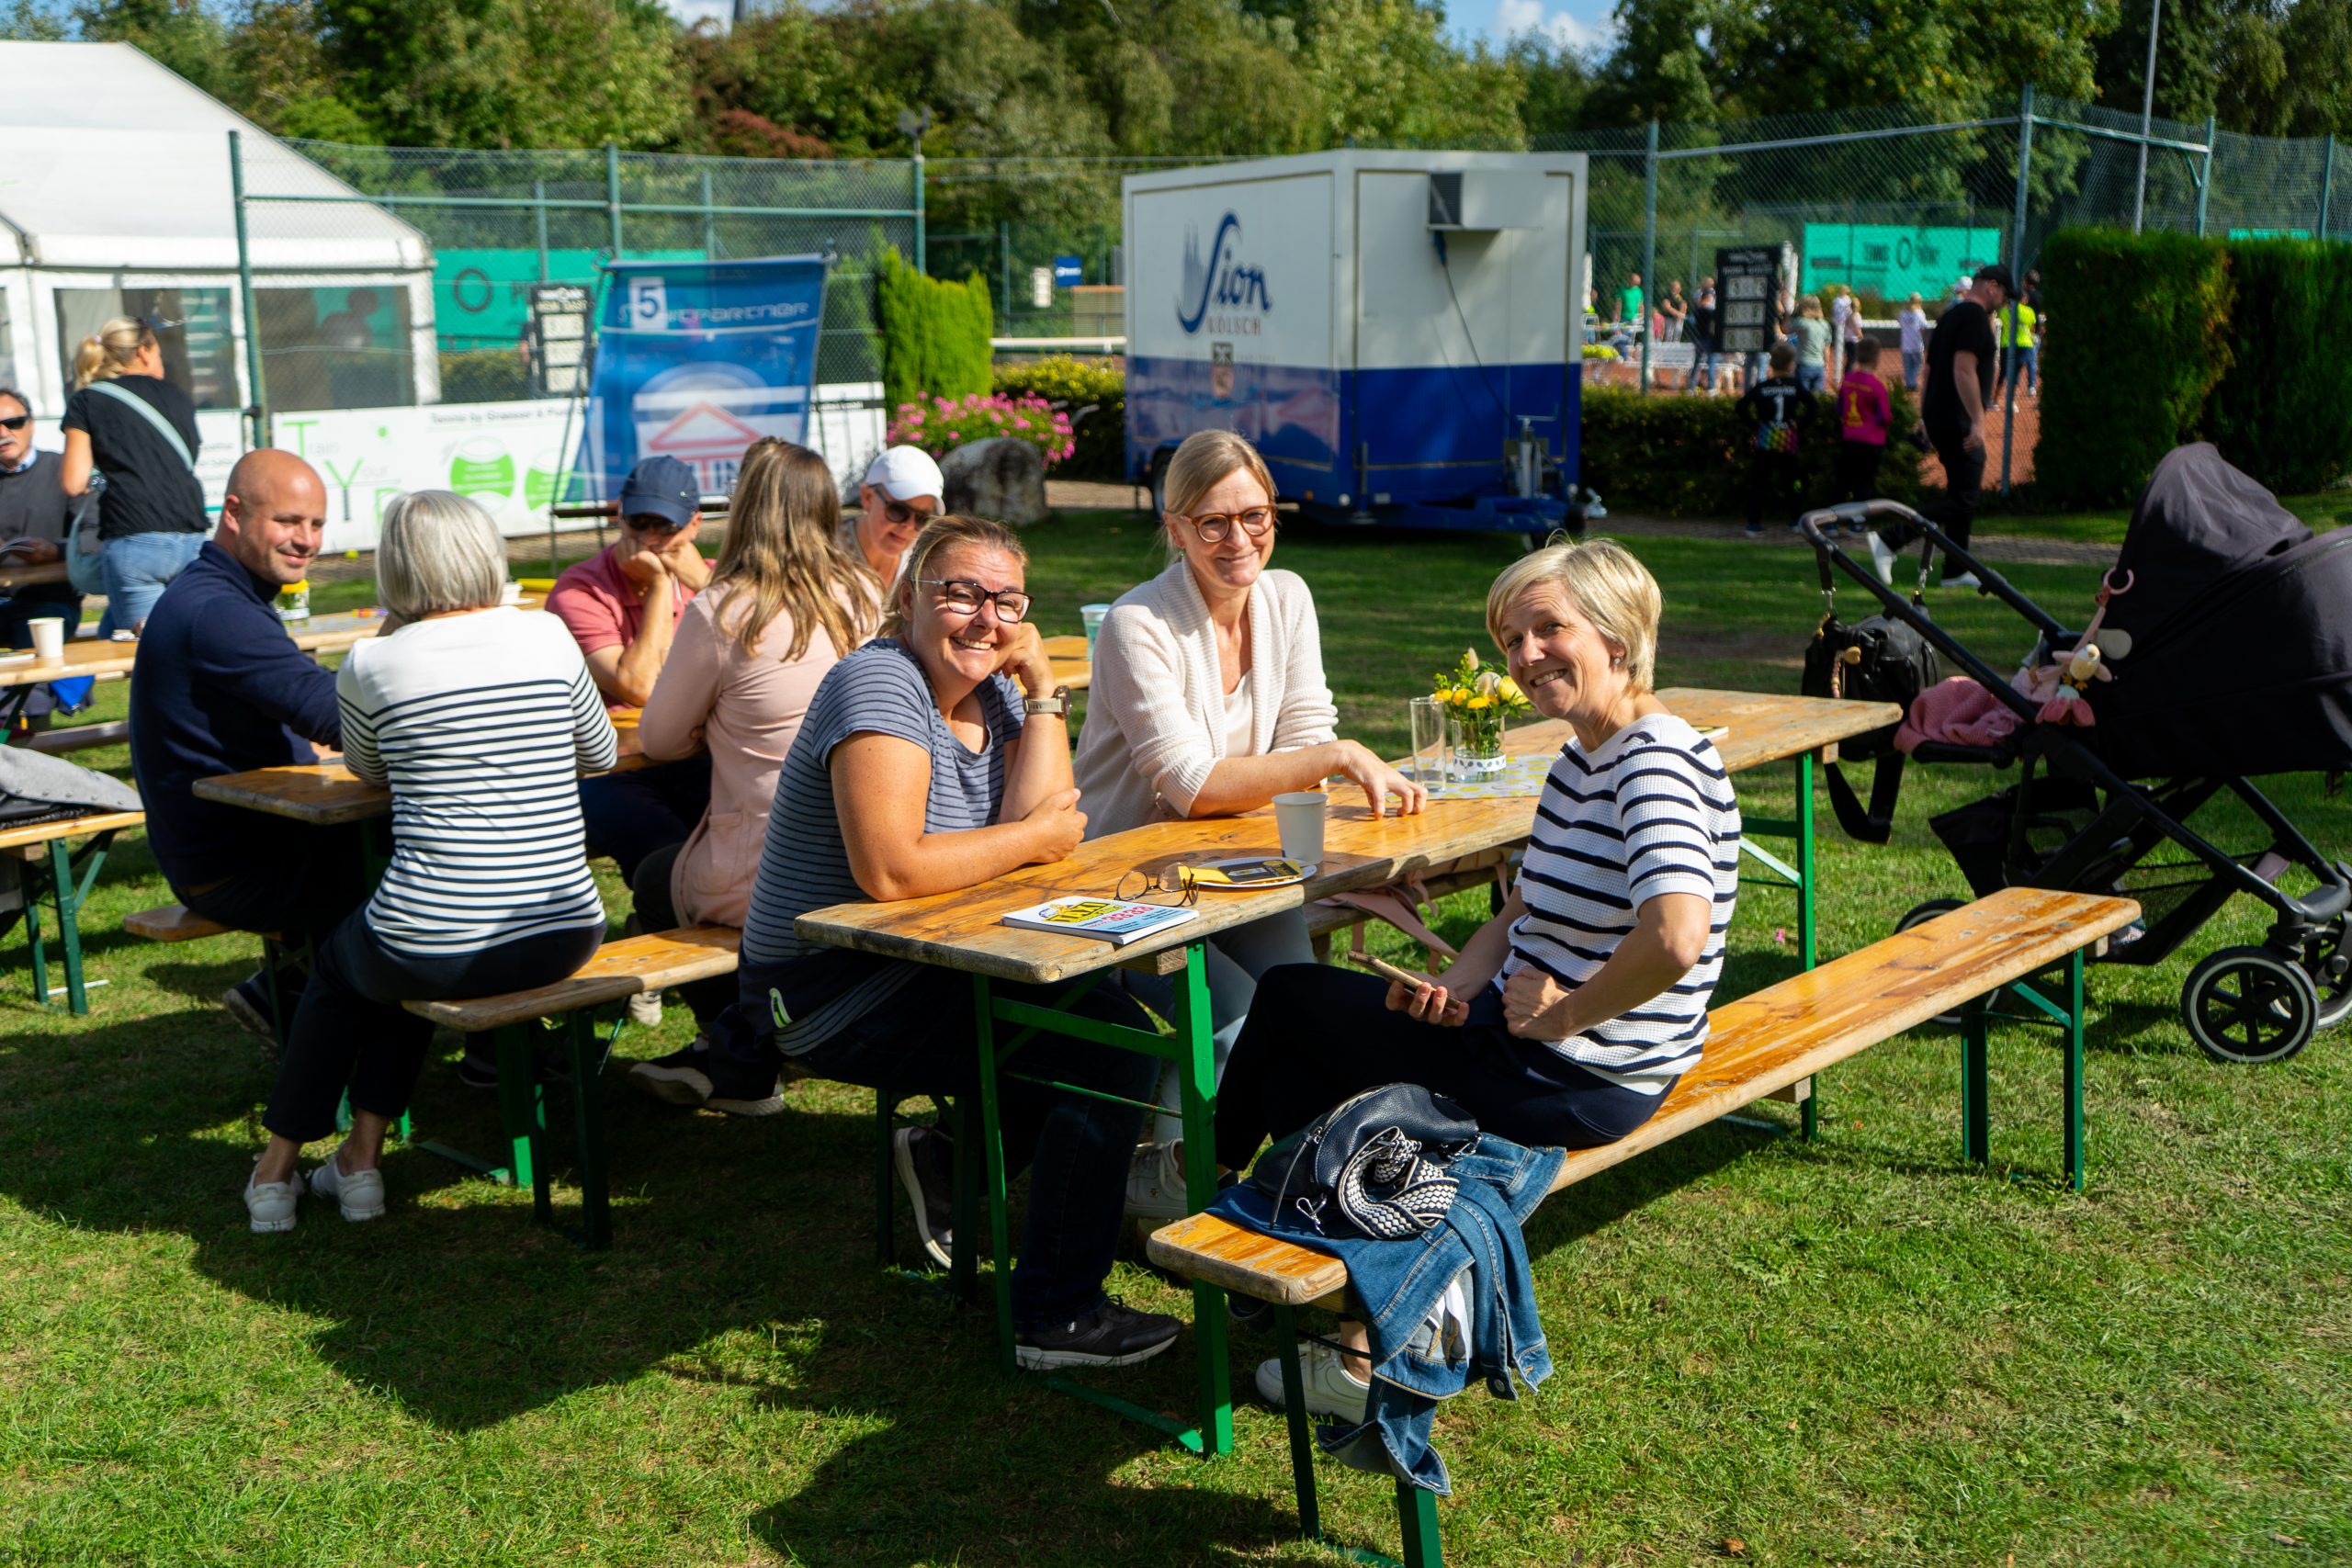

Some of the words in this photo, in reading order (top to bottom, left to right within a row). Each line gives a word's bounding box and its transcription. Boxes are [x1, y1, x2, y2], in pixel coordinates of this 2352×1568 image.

[1177, 211, 1272, 333] Sion
[639, 287, 659, 318] 5
[1772, 396, 1785, 422] 1
[1044, 901, 1113, 923] TAXI
